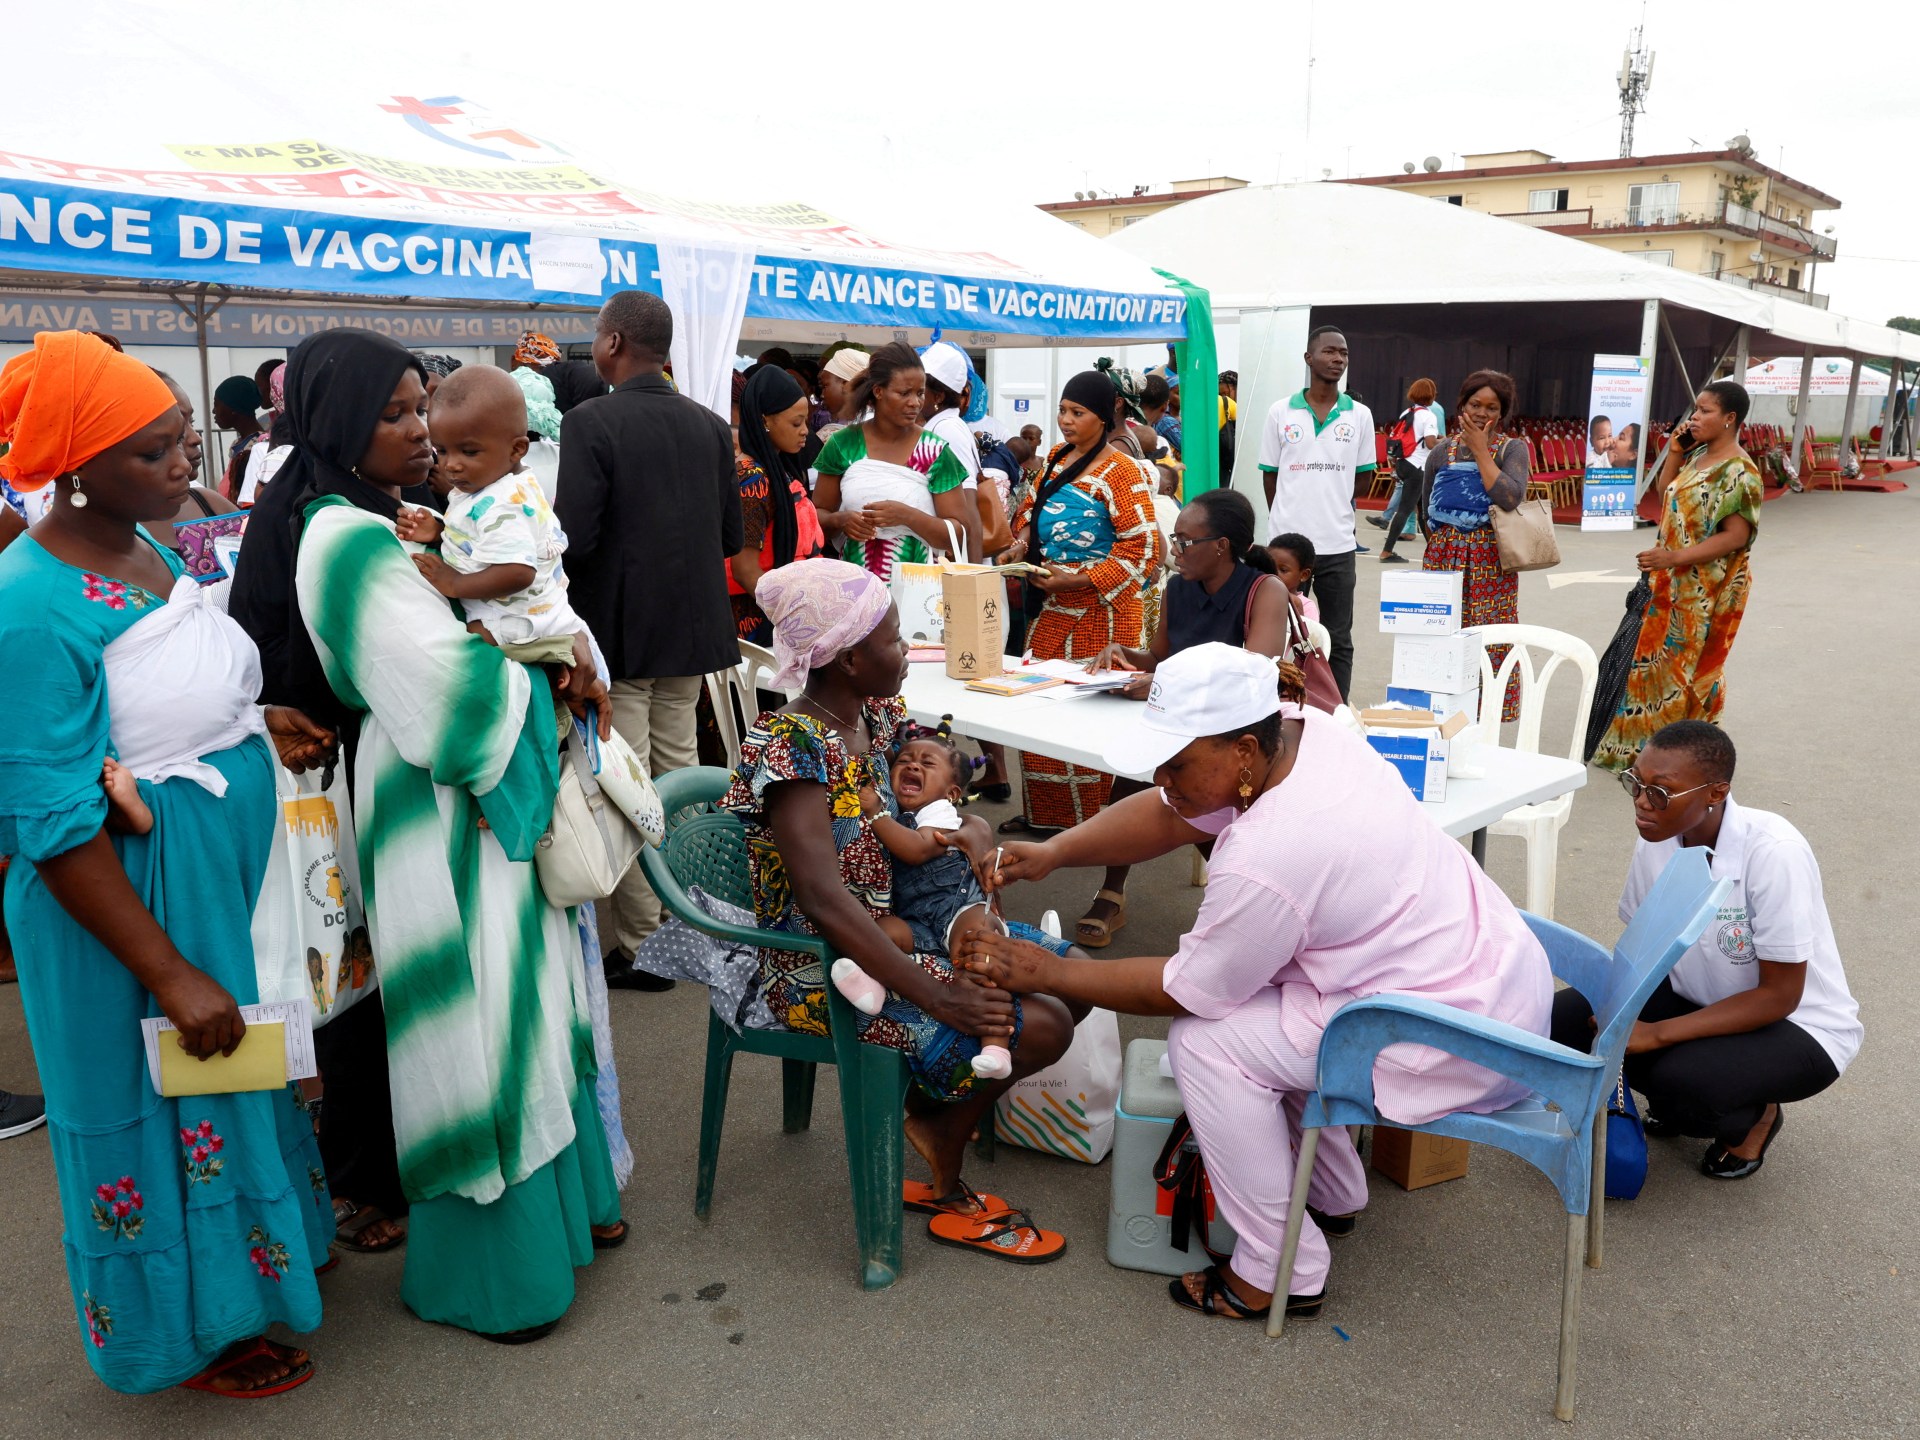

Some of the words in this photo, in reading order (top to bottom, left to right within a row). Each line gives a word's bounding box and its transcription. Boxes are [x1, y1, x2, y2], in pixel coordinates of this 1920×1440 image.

[215, 146, 283, 159] MA
[482, 170, 539, 180] VIE
[292, 153, 347, 169] DE
[178, 214, 263, 264] DE
[283, 225, 637, 286] VACCINAN
[677, 256, 797, 299] POTE
[808, 270, 935, 310] AVANCE
[946, 283, 979, 313] DE
[988, 288, 1146, 322] VACCINATION
[1148, 299, 1187, 323] PEV
[559, 261, 593, 270] SYMBOLIQUE
[1600, 400, 1631, 408] disponible
[1324, 463, 1335, 472] pour
[304, 859, 326, 908] PROGRAMME
[323, 911, 345, 927] DC
